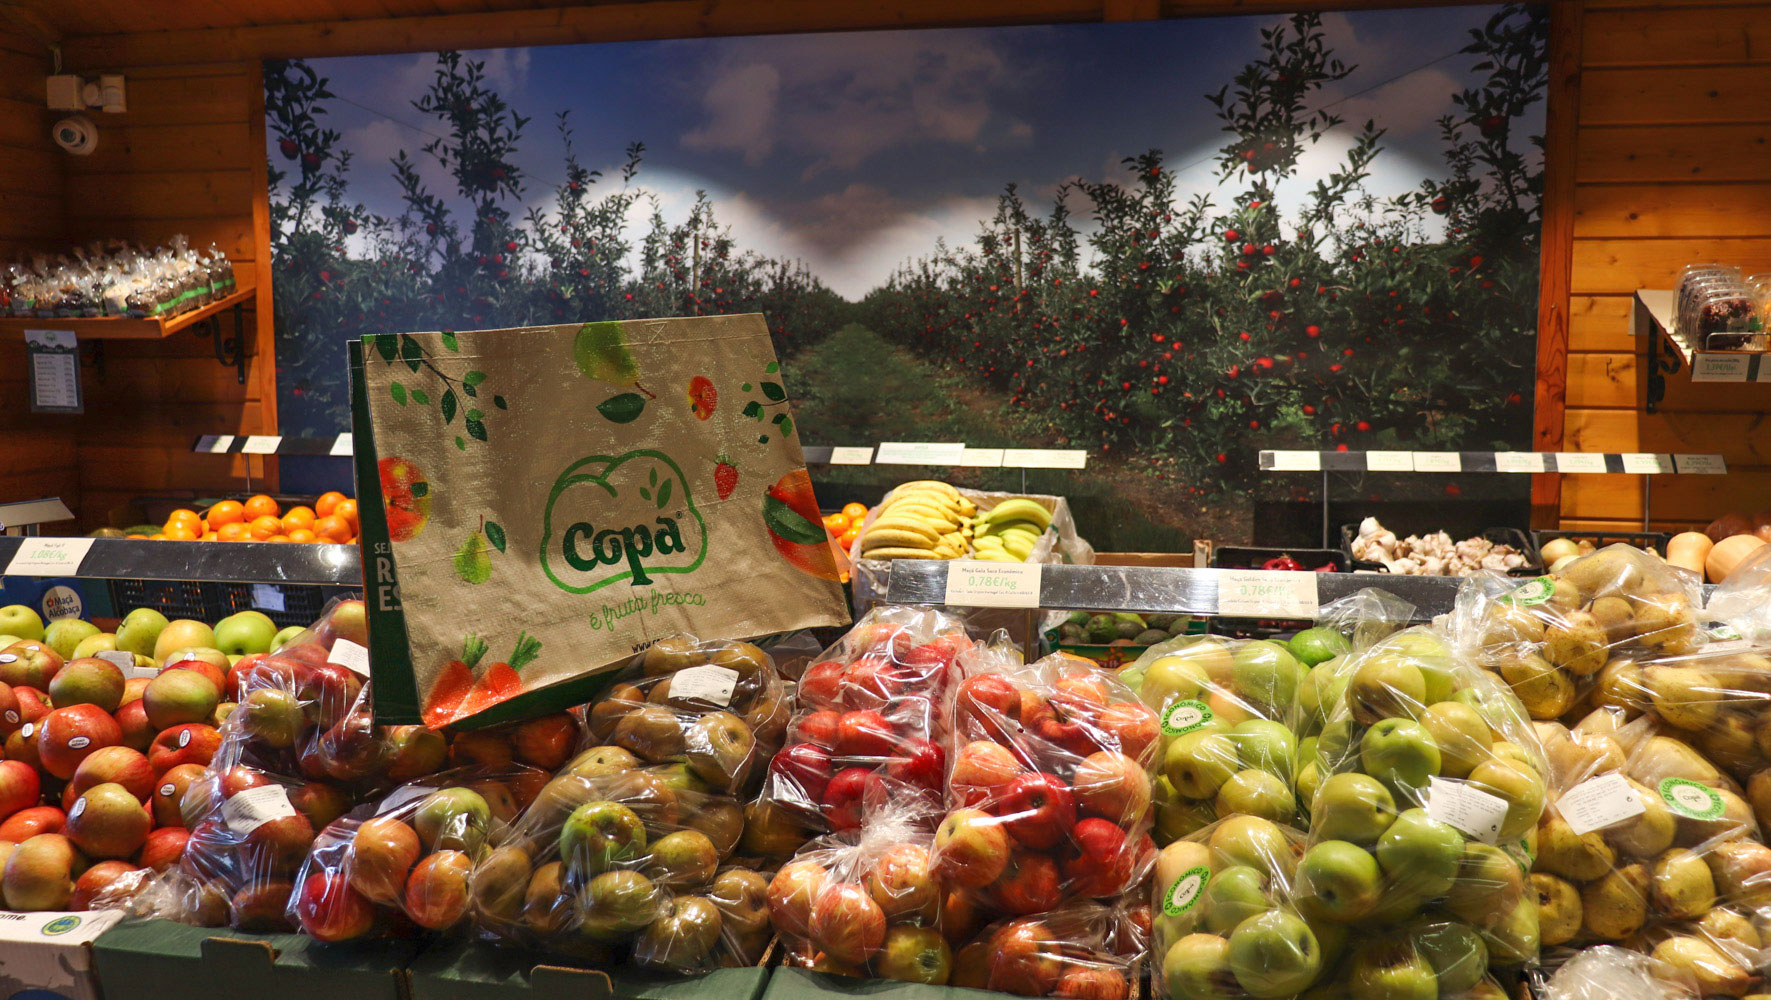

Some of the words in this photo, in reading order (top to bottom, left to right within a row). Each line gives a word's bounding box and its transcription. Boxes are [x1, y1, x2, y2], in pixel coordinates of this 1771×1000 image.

[374, 542, 391, 554] SEJ
[563, 516, 686, 586] Copa
[968, 576, 1017, 590] 0.78€/kg
[54, 594, 74, 605] Maçã
[48, 605, 80, 618] Alcobaça
[589, 612, 602, 630] é
[602, 596, 648, 632] fruta
[651, 588, 706, 615] fresca
